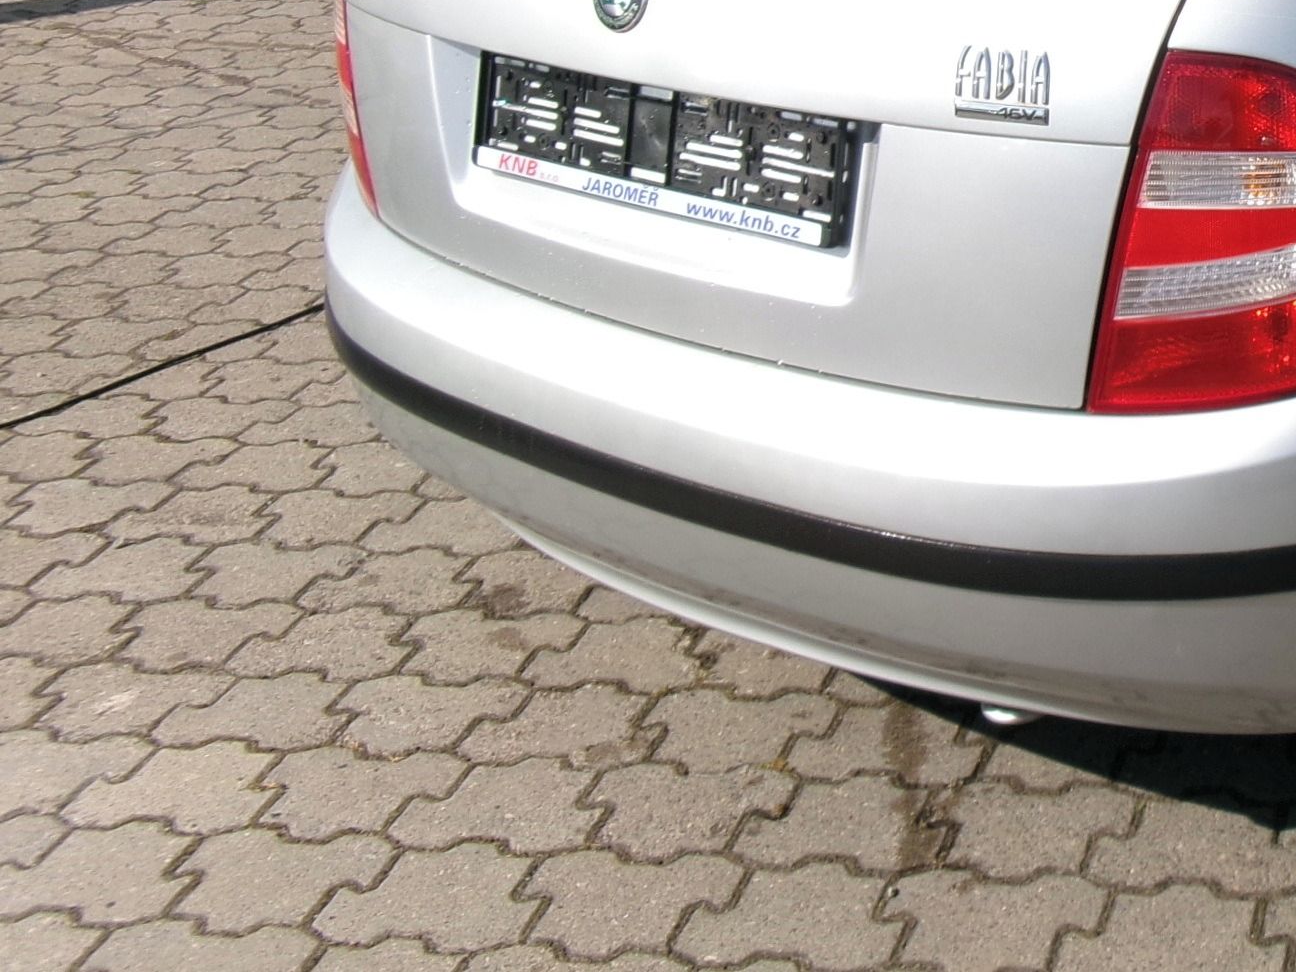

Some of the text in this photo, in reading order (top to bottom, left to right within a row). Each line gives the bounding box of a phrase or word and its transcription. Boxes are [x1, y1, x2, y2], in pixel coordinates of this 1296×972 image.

[954, 44, 1051, 106] FABIA
[498, 153, 538, 176] KNB
[582, 177, 660, 207] JAROMĚŘ
[686, 202, 801, 239] www.knb.cz
